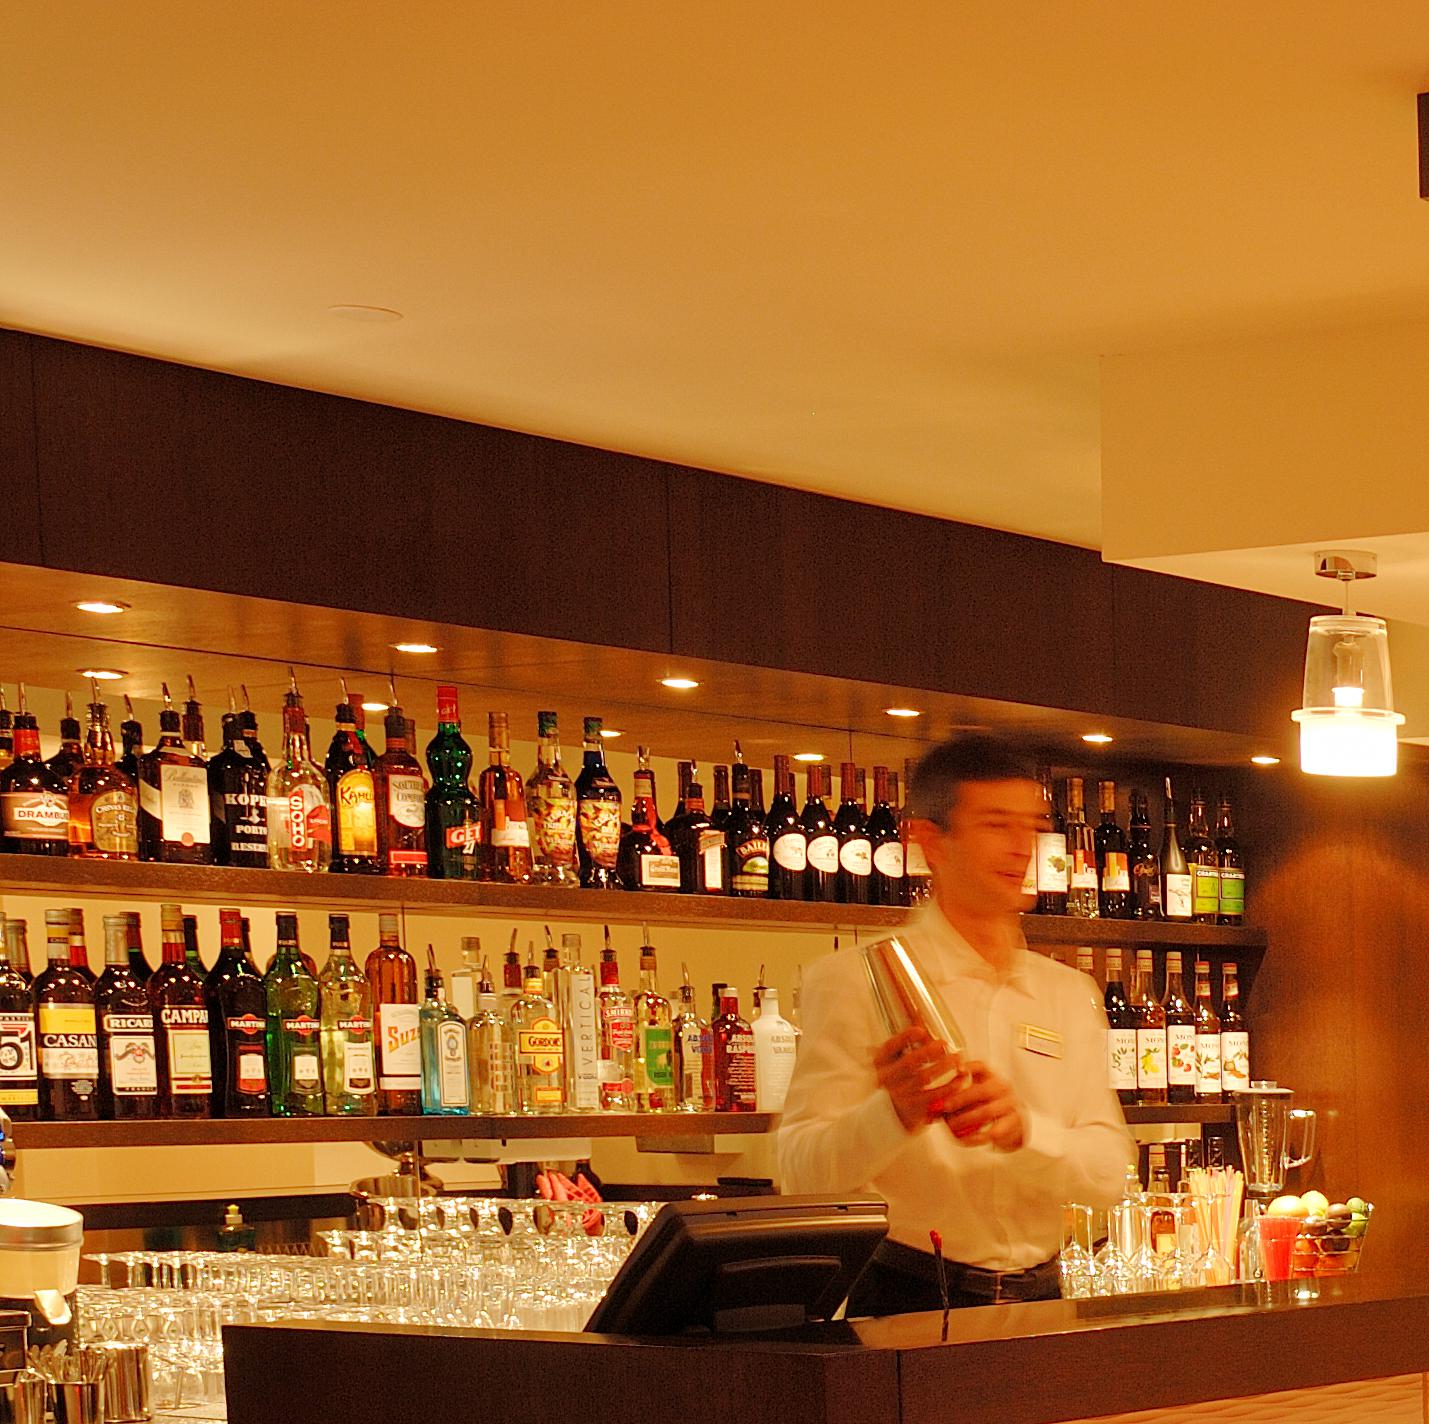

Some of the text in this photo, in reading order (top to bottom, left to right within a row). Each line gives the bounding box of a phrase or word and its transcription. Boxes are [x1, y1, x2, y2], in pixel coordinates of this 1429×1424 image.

[290, 795, 306, 847] SOHO
[451, 824, 483, 844] GET
[579, 976, 594, 1066] VERTICAL
